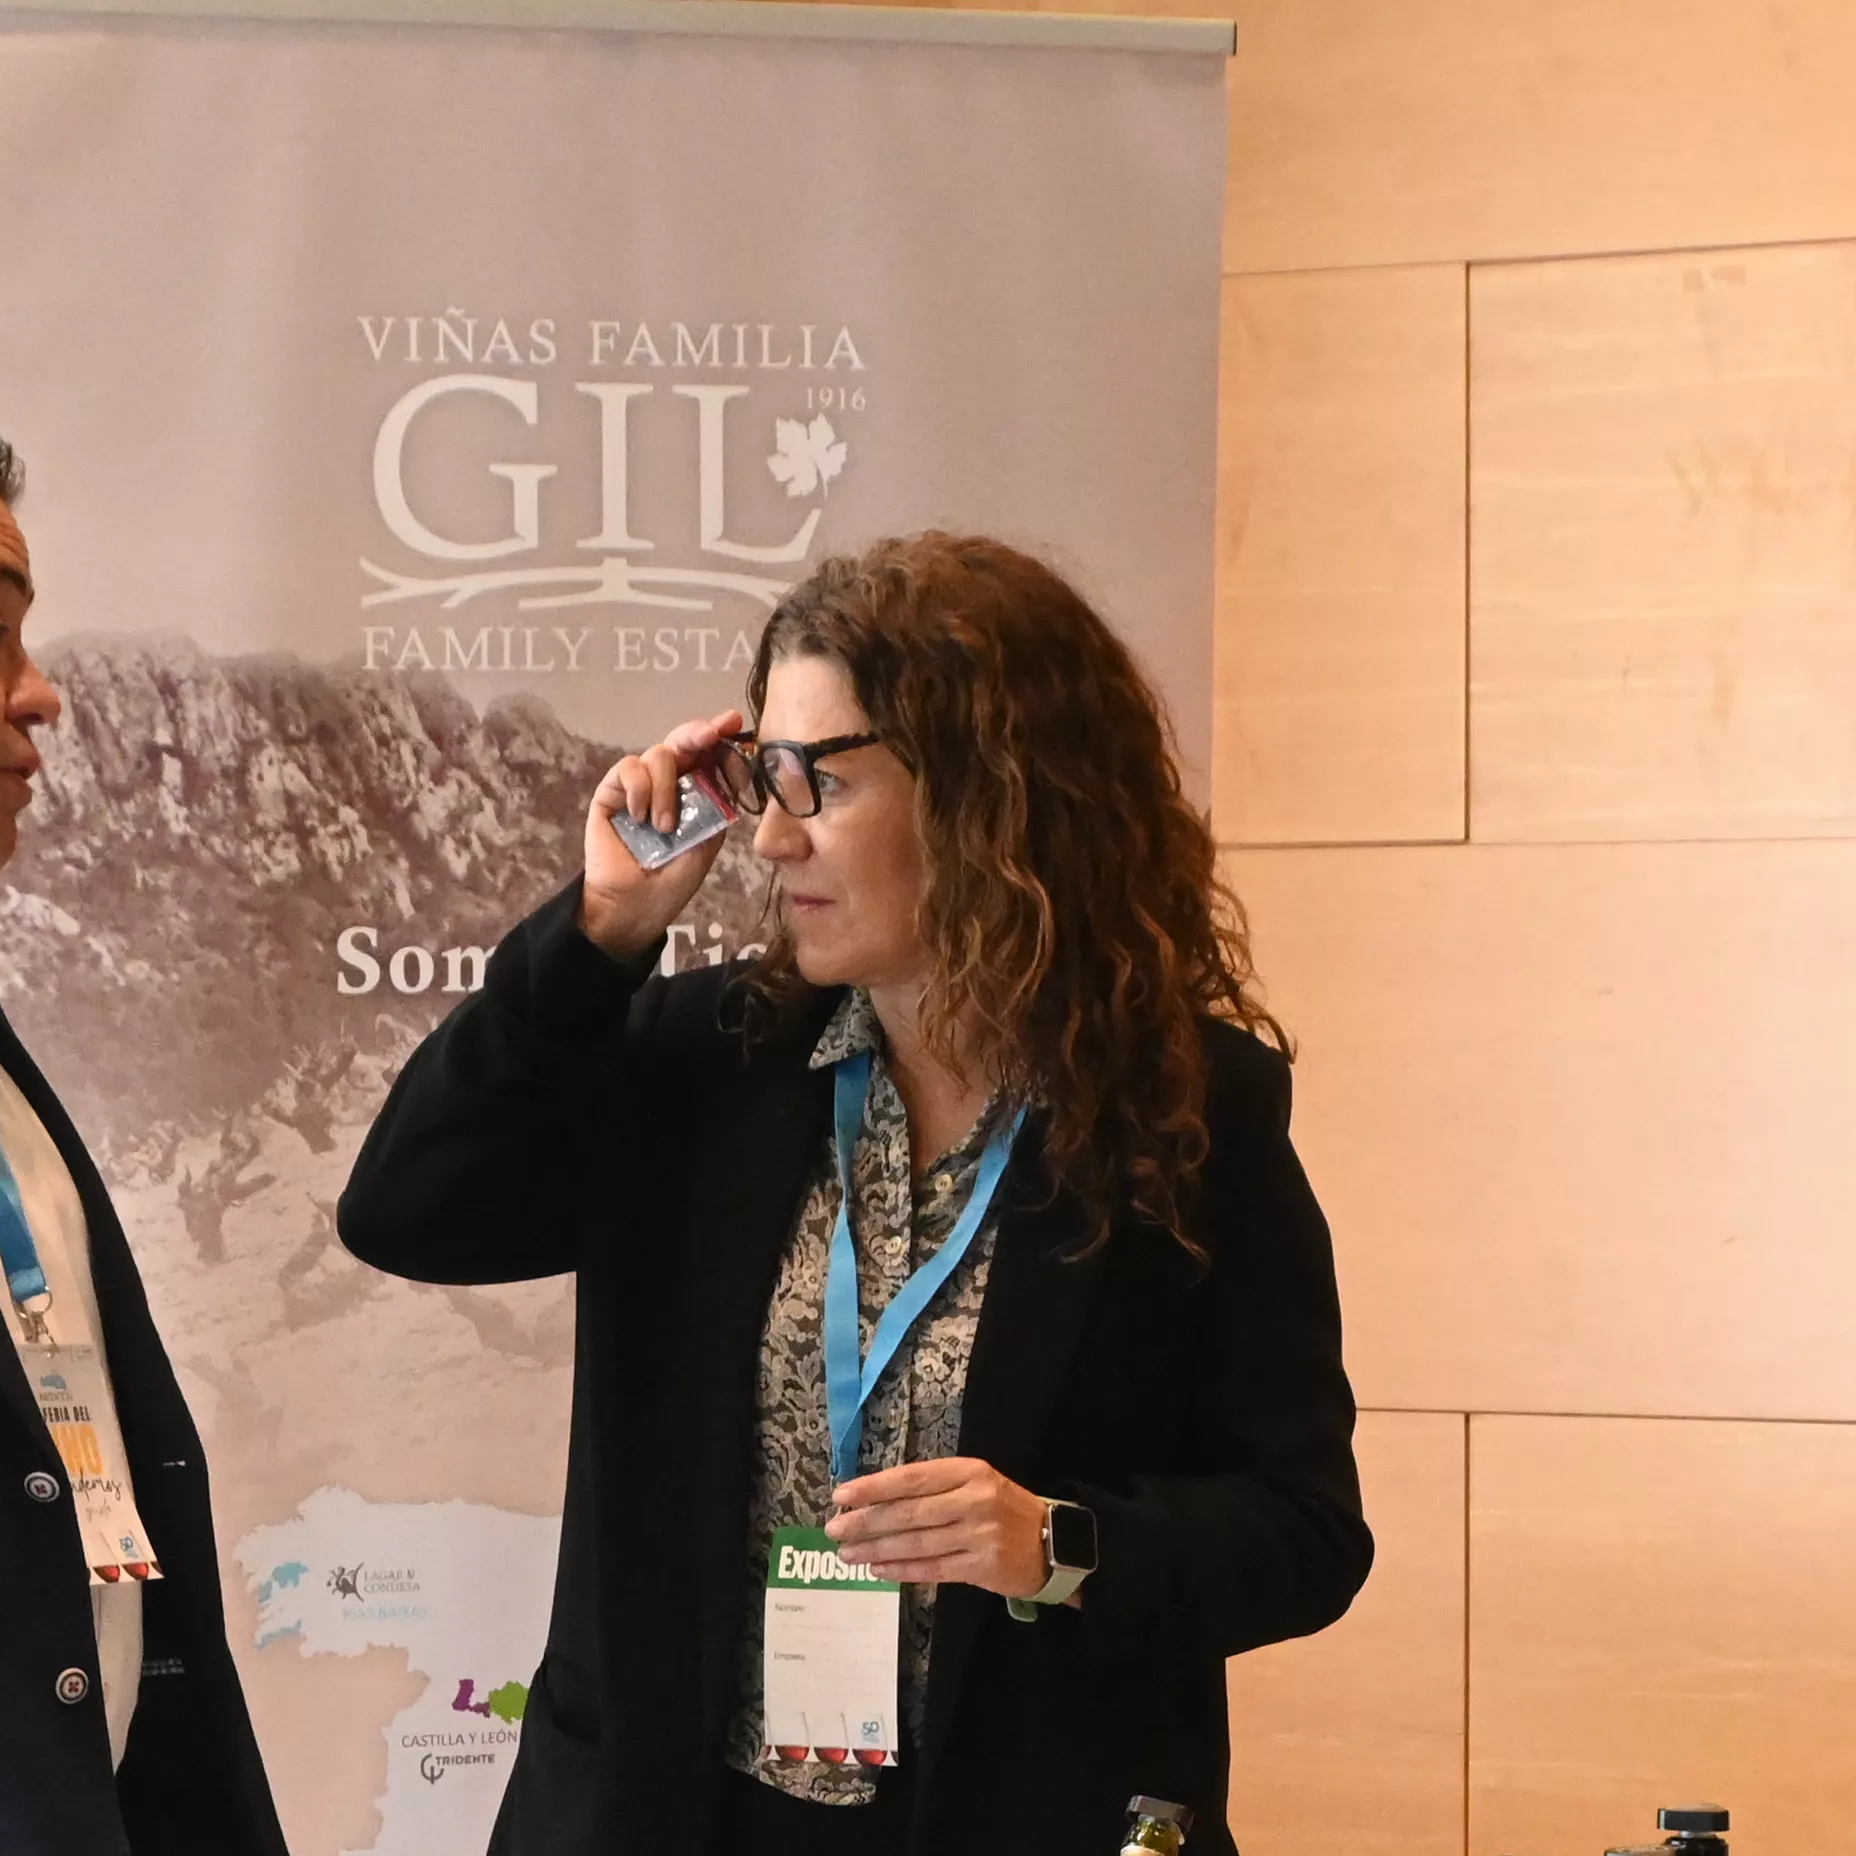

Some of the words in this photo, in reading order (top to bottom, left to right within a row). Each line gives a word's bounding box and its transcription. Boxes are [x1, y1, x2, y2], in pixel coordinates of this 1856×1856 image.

[358, 305, 557, 366] VIÑAS
[588, 320, 867, 369] FAMILIA
[805, 386, 866, 412] 1916
[372, 373, 822, 564] GIL
[361, 626, 593, 672] FAMILY
[616, 627, 754, 671] ESTA
[364, 1581, 420, 1594] CONDESA
[401, 1732, 465, 1749] CASTILLA
[469, 1732, 478, 1745] Y
[481, 1728, 518, 1746] LEÓN
[436, 1753, 495, 1767] TRIDENTE
